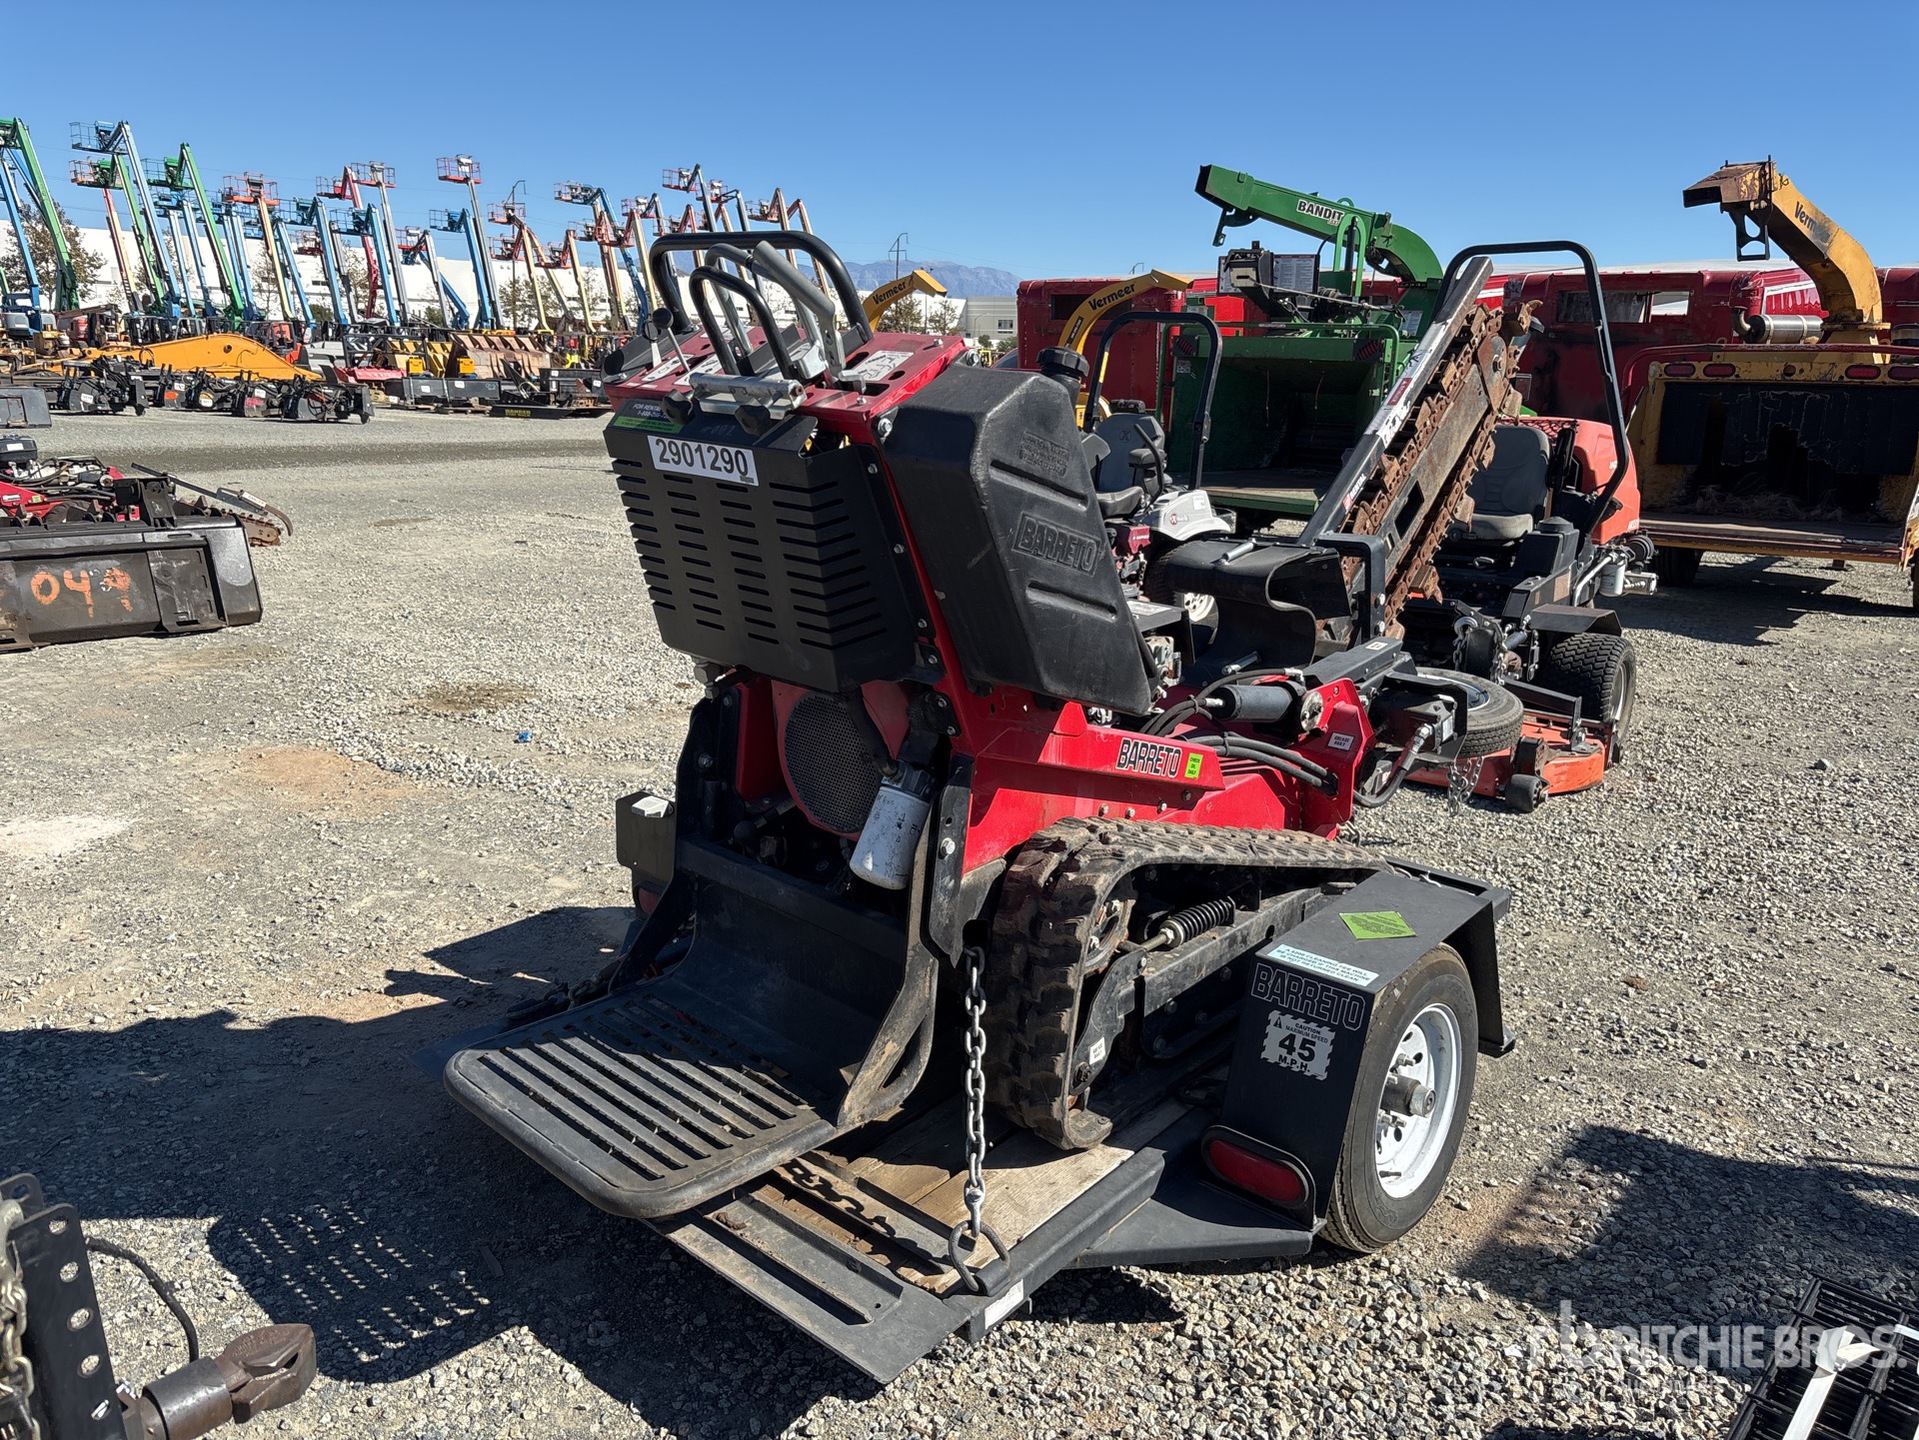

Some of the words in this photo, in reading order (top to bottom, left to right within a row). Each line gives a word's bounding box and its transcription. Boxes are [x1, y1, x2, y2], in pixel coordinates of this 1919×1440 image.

[1297, 200, 1343, 222] BANDIT
[873, 281, 908, 305] Vermeer
[1088, 282, 1135, 311] Vermeer
[656, 439, 748, 477] 2901290
[1017, 516, 1097, 572] BARRETO
[1116, 738, 1182, 778] BARRETO
[1286, 953, 1318, 964] CHARGED
[1340, 969, 1371, 980] MACHINE
[1300, 961, 1336, 974] RETURNED
[1336, 972, 1359, 981] CLEAN
[1305, 954, 1338, 966] CLEANING
[1251, 963, 1366, 1031] BARRETO
[1285, 1025, 1310, 1038] MAXIMUM
[1310, 1033, 1329, 1044] SPEED
[1295, 1022, 1321, 1035] CAUTION
[1278, 1033, 1316, 1062] 45
[1278, 1054, 1310, 1072] M.P.H.
